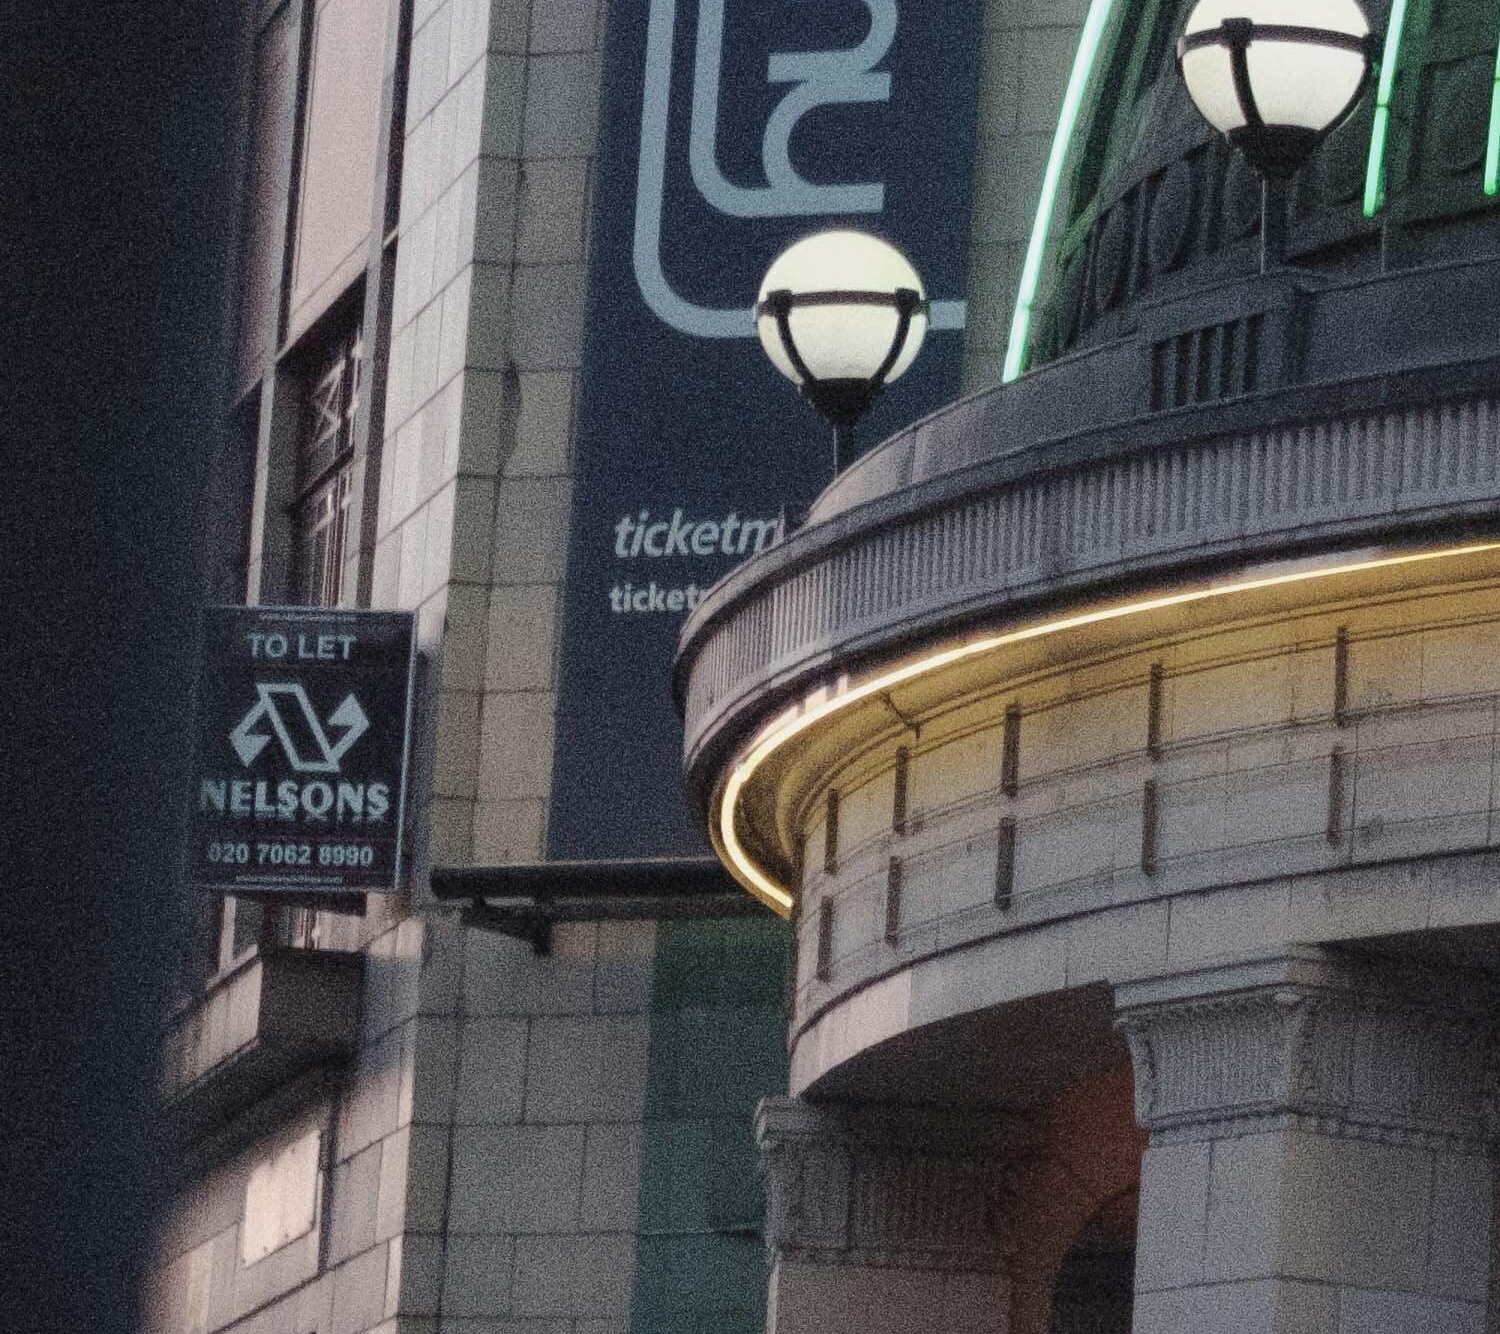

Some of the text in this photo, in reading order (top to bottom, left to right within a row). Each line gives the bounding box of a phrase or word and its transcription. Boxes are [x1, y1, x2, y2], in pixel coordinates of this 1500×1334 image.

[614, 509, 780, 558] ticketm
[608, 583, 702, 613] ticket
[248, 633, 357, 660] TO LET
[201, 780, 390, 818] NELSONS
